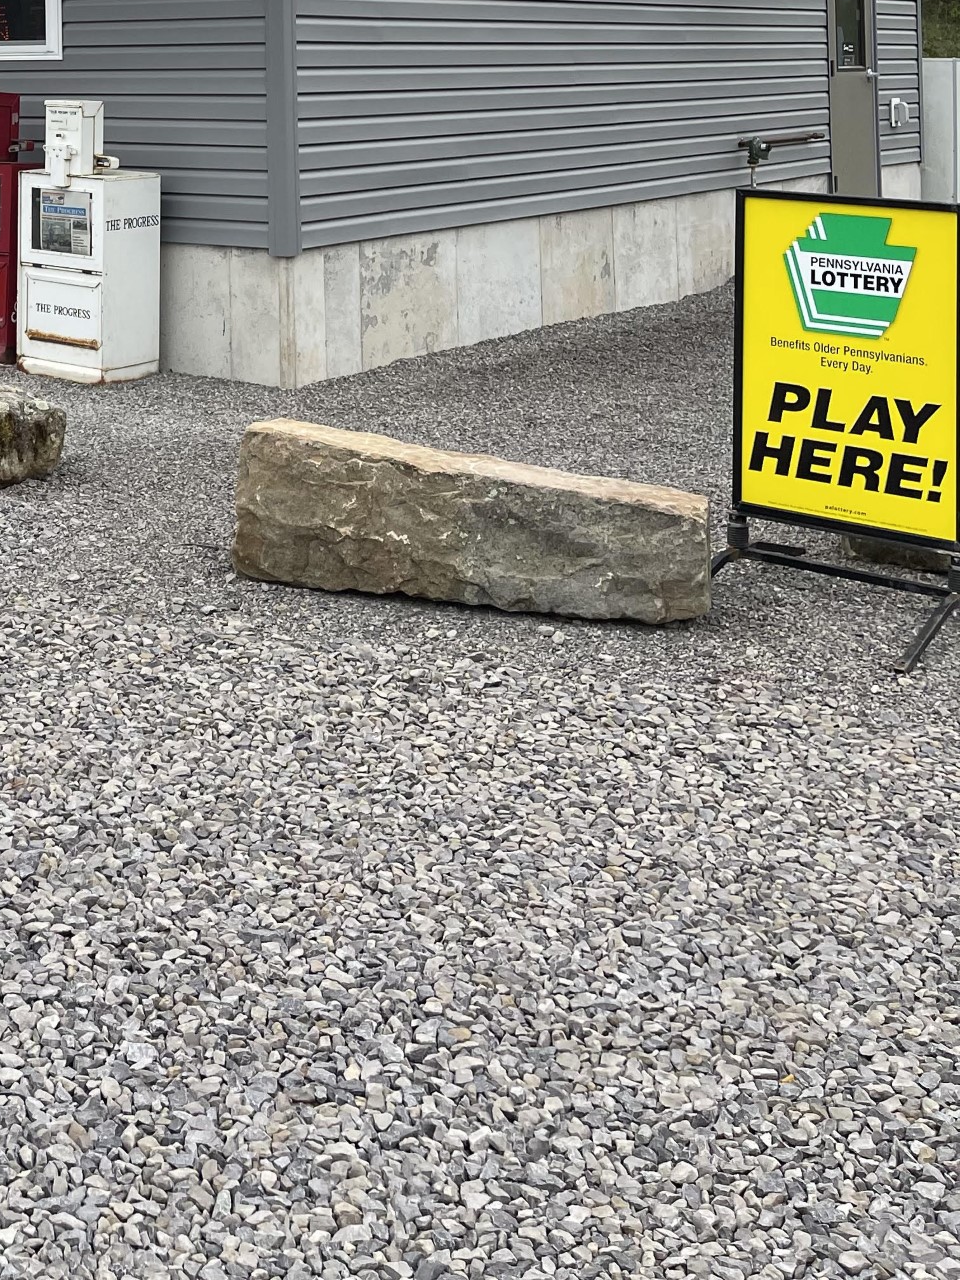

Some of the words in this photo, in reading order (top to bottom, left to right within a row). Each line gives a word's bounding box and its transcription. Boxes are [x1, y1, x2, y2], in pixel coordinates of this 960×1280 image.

[105, 219, 121, 231] THE
[123, 214, 160, 230] PROGRESS
[810, 256, 904, 276] PENNSYLVANIA
[810, 269, 904, 294] LOTTERY
[35, 302, 51, 314] THE
[53, 304, 91, 320] PROGRESS
[770, 336, 811, 351] Benefits
[813, 341, 840, 355] Older
[843, 345, 928, 366] Pennsylvanians.
[820, 356, 849, 372] Every
[851, 360, 873, 375] Day.
[767, 381, 942, 445] PLAY
[748, 430, 949, 504] HERE!
[824, 505, 867, 517] palottery.com
